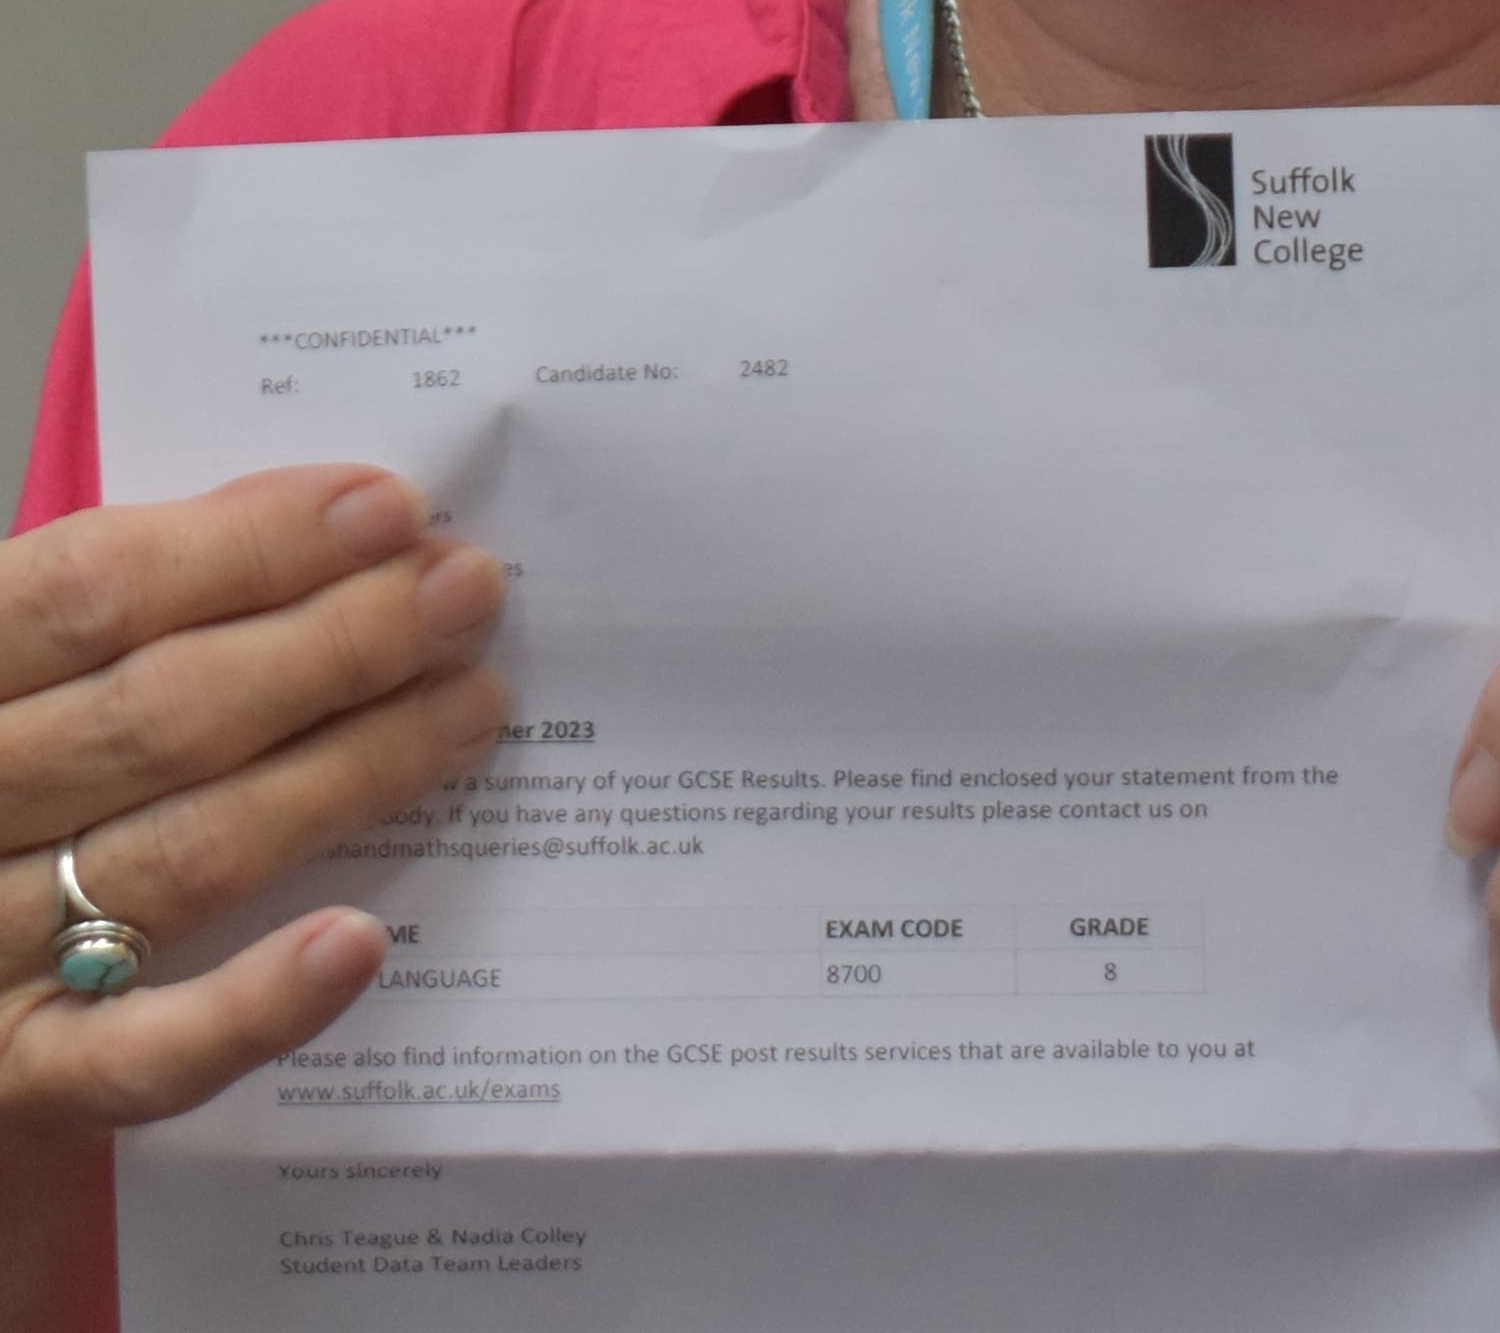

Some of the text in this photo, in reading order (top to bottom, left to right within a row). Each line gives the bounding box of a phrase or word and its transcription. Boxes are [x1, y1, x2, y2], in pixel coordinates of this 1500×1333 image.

[1251, 165, 1357, 195] Suffolk
[1253, 204, 1322, 231] New
[1253, 236, 1365, 272] College
[260, 358, 789, 395] Ref: 1862 Candidate No: 2482
[541, 720, 596, 742] 2023
[465, 776, 478, 791] a
[484, 775, 587, 795] summary
[592, 770, 616, 789] of
[622, 774, 672, 793] your
[677, 770, 734, 789] GCSE
[741, 769, 826, 789] Results.
[833, 769, 904, 788] Please
[910, 768, 953, 787] find
[959, 767, 1058, 787] enclosed
[1063, 771, 1115, 791] your
[1121, 767, 1236, 786] statement
[1241, 765, 1296, 785] from
[1301, 765, 1340, 785] the
[449, 805, 463, 822] If
[469, 809, 509, 828] you
[516, 804, 568, 823] have
[574, 808, 614, 826] any
[619, 802, 727, 825] questions
[733, 801, 839, 825] regarding
[844, 805, 895, 824] your
[901, 800, 976, 820] results
[981, 800, 1053, 823] please
[1058, 801, 1142, 819] contact
[1148, 803, 1174, 819] us
[1179, 803, 1209, 819] on
[825, 919, 894, 939] EXAM
[900, 918, 964, 938] CODE
[1069, 916, 1150, 937] GRADE
[378, 962, 1118, 989] LANGUAGE 8700 8
[277, 1038, 1256, 1069] Please also find information on the GCSE post results services that are available to you at
[277, 1079, 562, 1104] www.suffolk.ac.uk/exams
[278, 1161, 443, 1182] Yours sincerely
[279, 1226, 587, 1251] Chris Teague & Nadia Colley
[279, 1252, 583, 1275] Student Data Team Leaders
